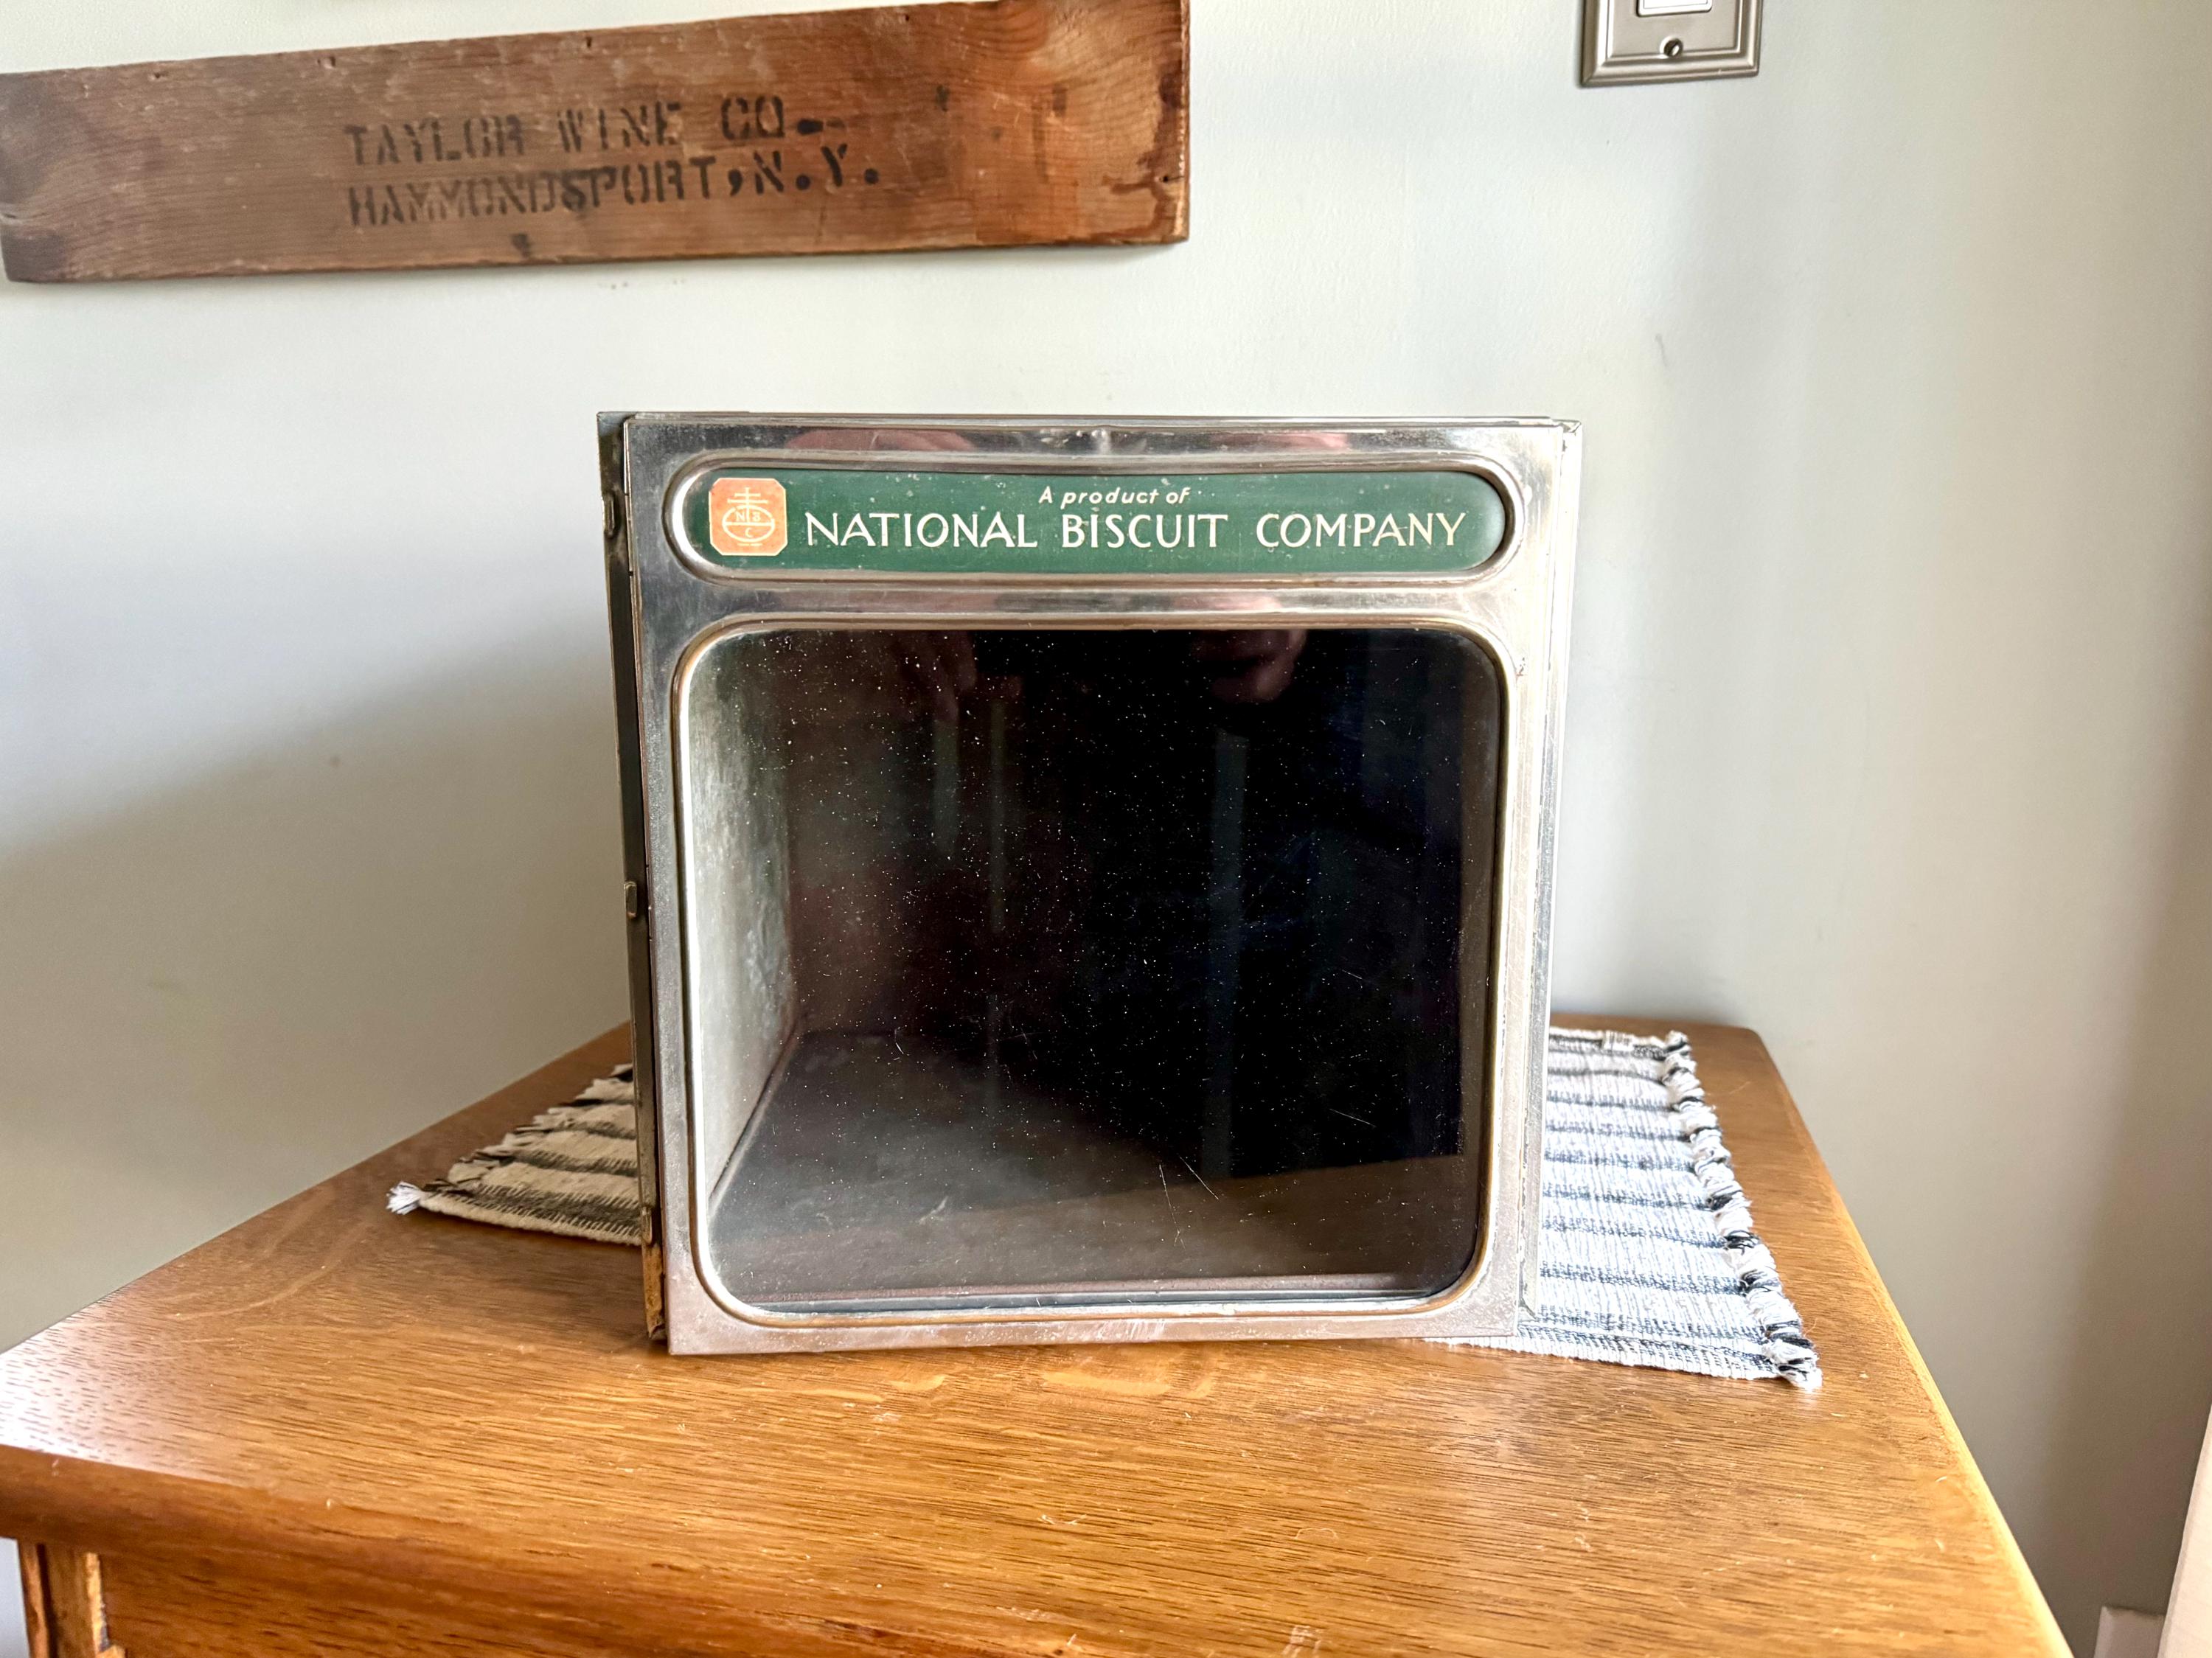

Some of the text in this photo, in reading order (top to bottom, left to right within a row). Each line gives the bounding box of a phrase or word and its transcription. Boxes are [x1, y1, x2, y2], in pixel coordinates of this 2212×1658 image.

[344, 114, 524, 166] TAYLOR
[557, 102, 682, 153] WINE
[1039, 486, 1190, 509] A product of
[805, 512, 1467, 548] NATIONAL BISCUIT COMPANY
